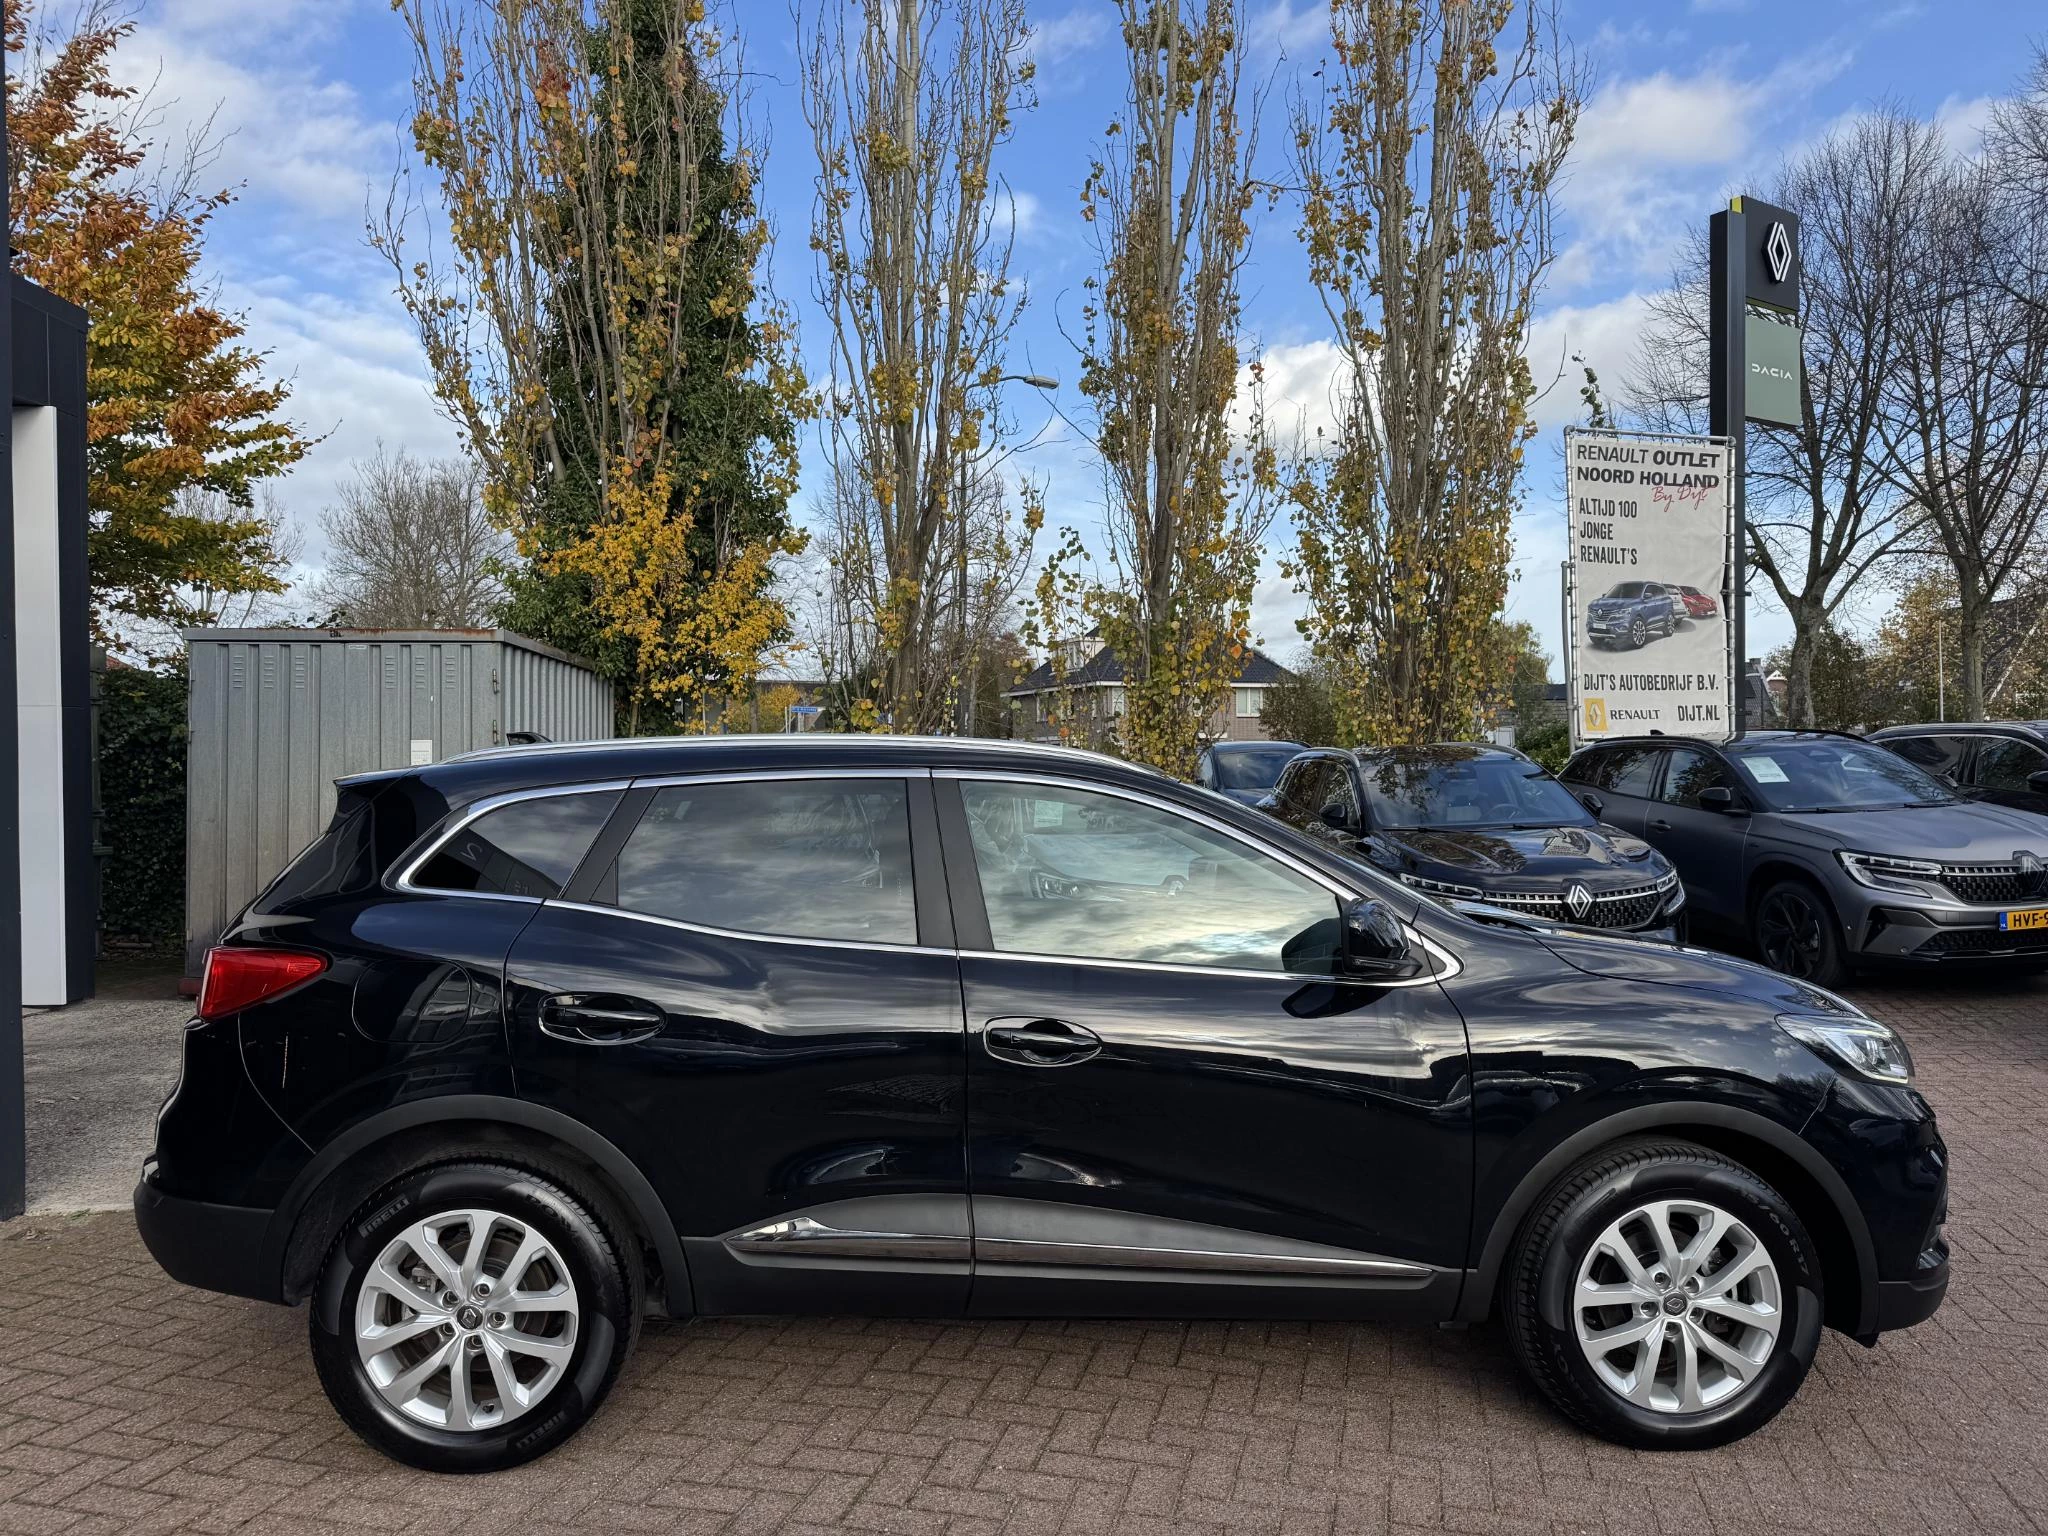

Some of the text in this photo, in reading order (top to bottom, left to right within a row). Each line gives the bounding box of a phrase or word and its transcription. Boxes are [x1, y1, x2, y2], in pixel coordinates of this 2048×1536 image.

[1751, 363, 1793, 380] DACIA
[1577, 445, 1720, 468] RENAULT OUTLET
[1577, 466, 1720, 489] NOORD HOLLAND
[1579, 498, 1638, 518] ALTIJD 100
[1652, 486, 1674, 512] By
[1580, 521, 1613, 540] JONGE
[1580, 545, 1638, 565] RENAULT'S
[1583, 673, 1719, 691] DIJT'S AUTOBEDRIJF B.V.
[1610, 705, 1720, 721] RENAULT DIJT.NL
